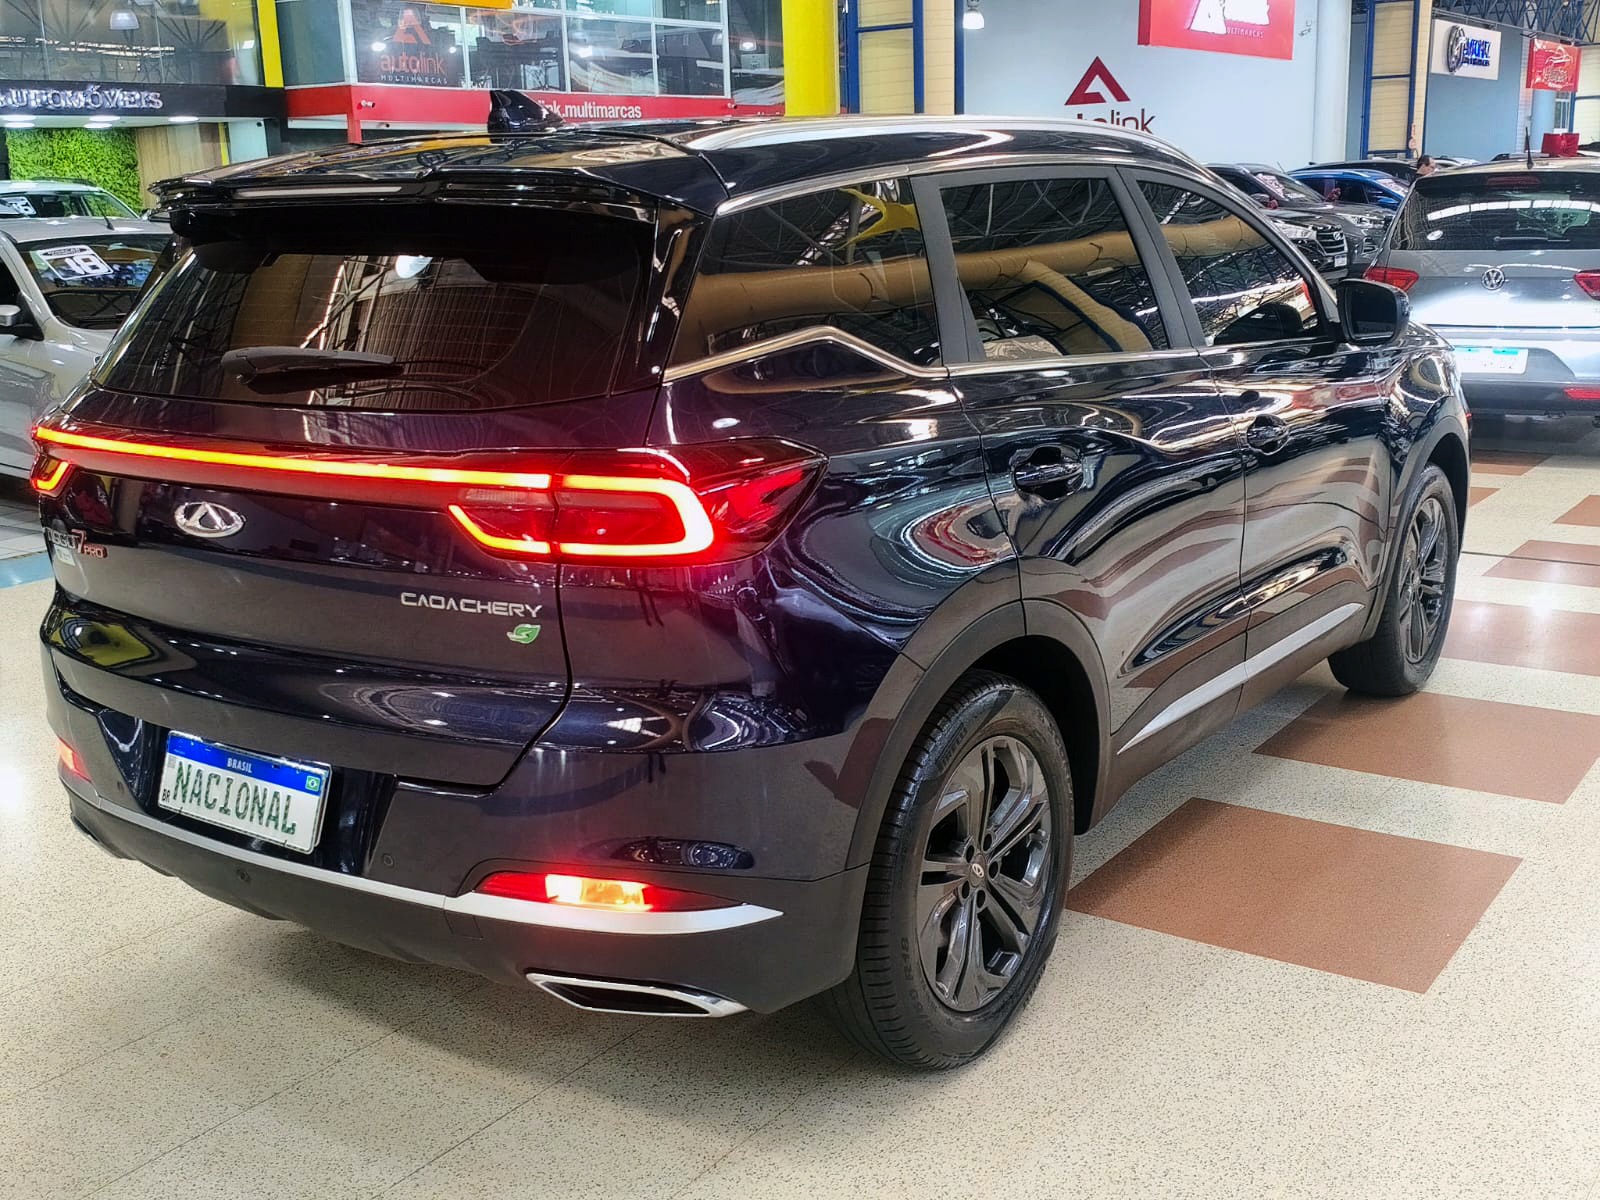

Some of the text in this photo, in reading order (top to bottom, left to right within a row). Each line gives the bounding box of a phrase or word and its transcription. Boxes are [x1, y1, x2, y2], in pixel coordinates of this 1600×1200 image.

[380, 50, 447, 75] autolink
[380, 75, 448, 86] MULTIMARCAS
[84, 545, 105, 559] PRO
[226, 757, 253, 774] BRASIL
[161, 788, 171, 804] BR
[172, 760, 297, 835] NACIONAL
